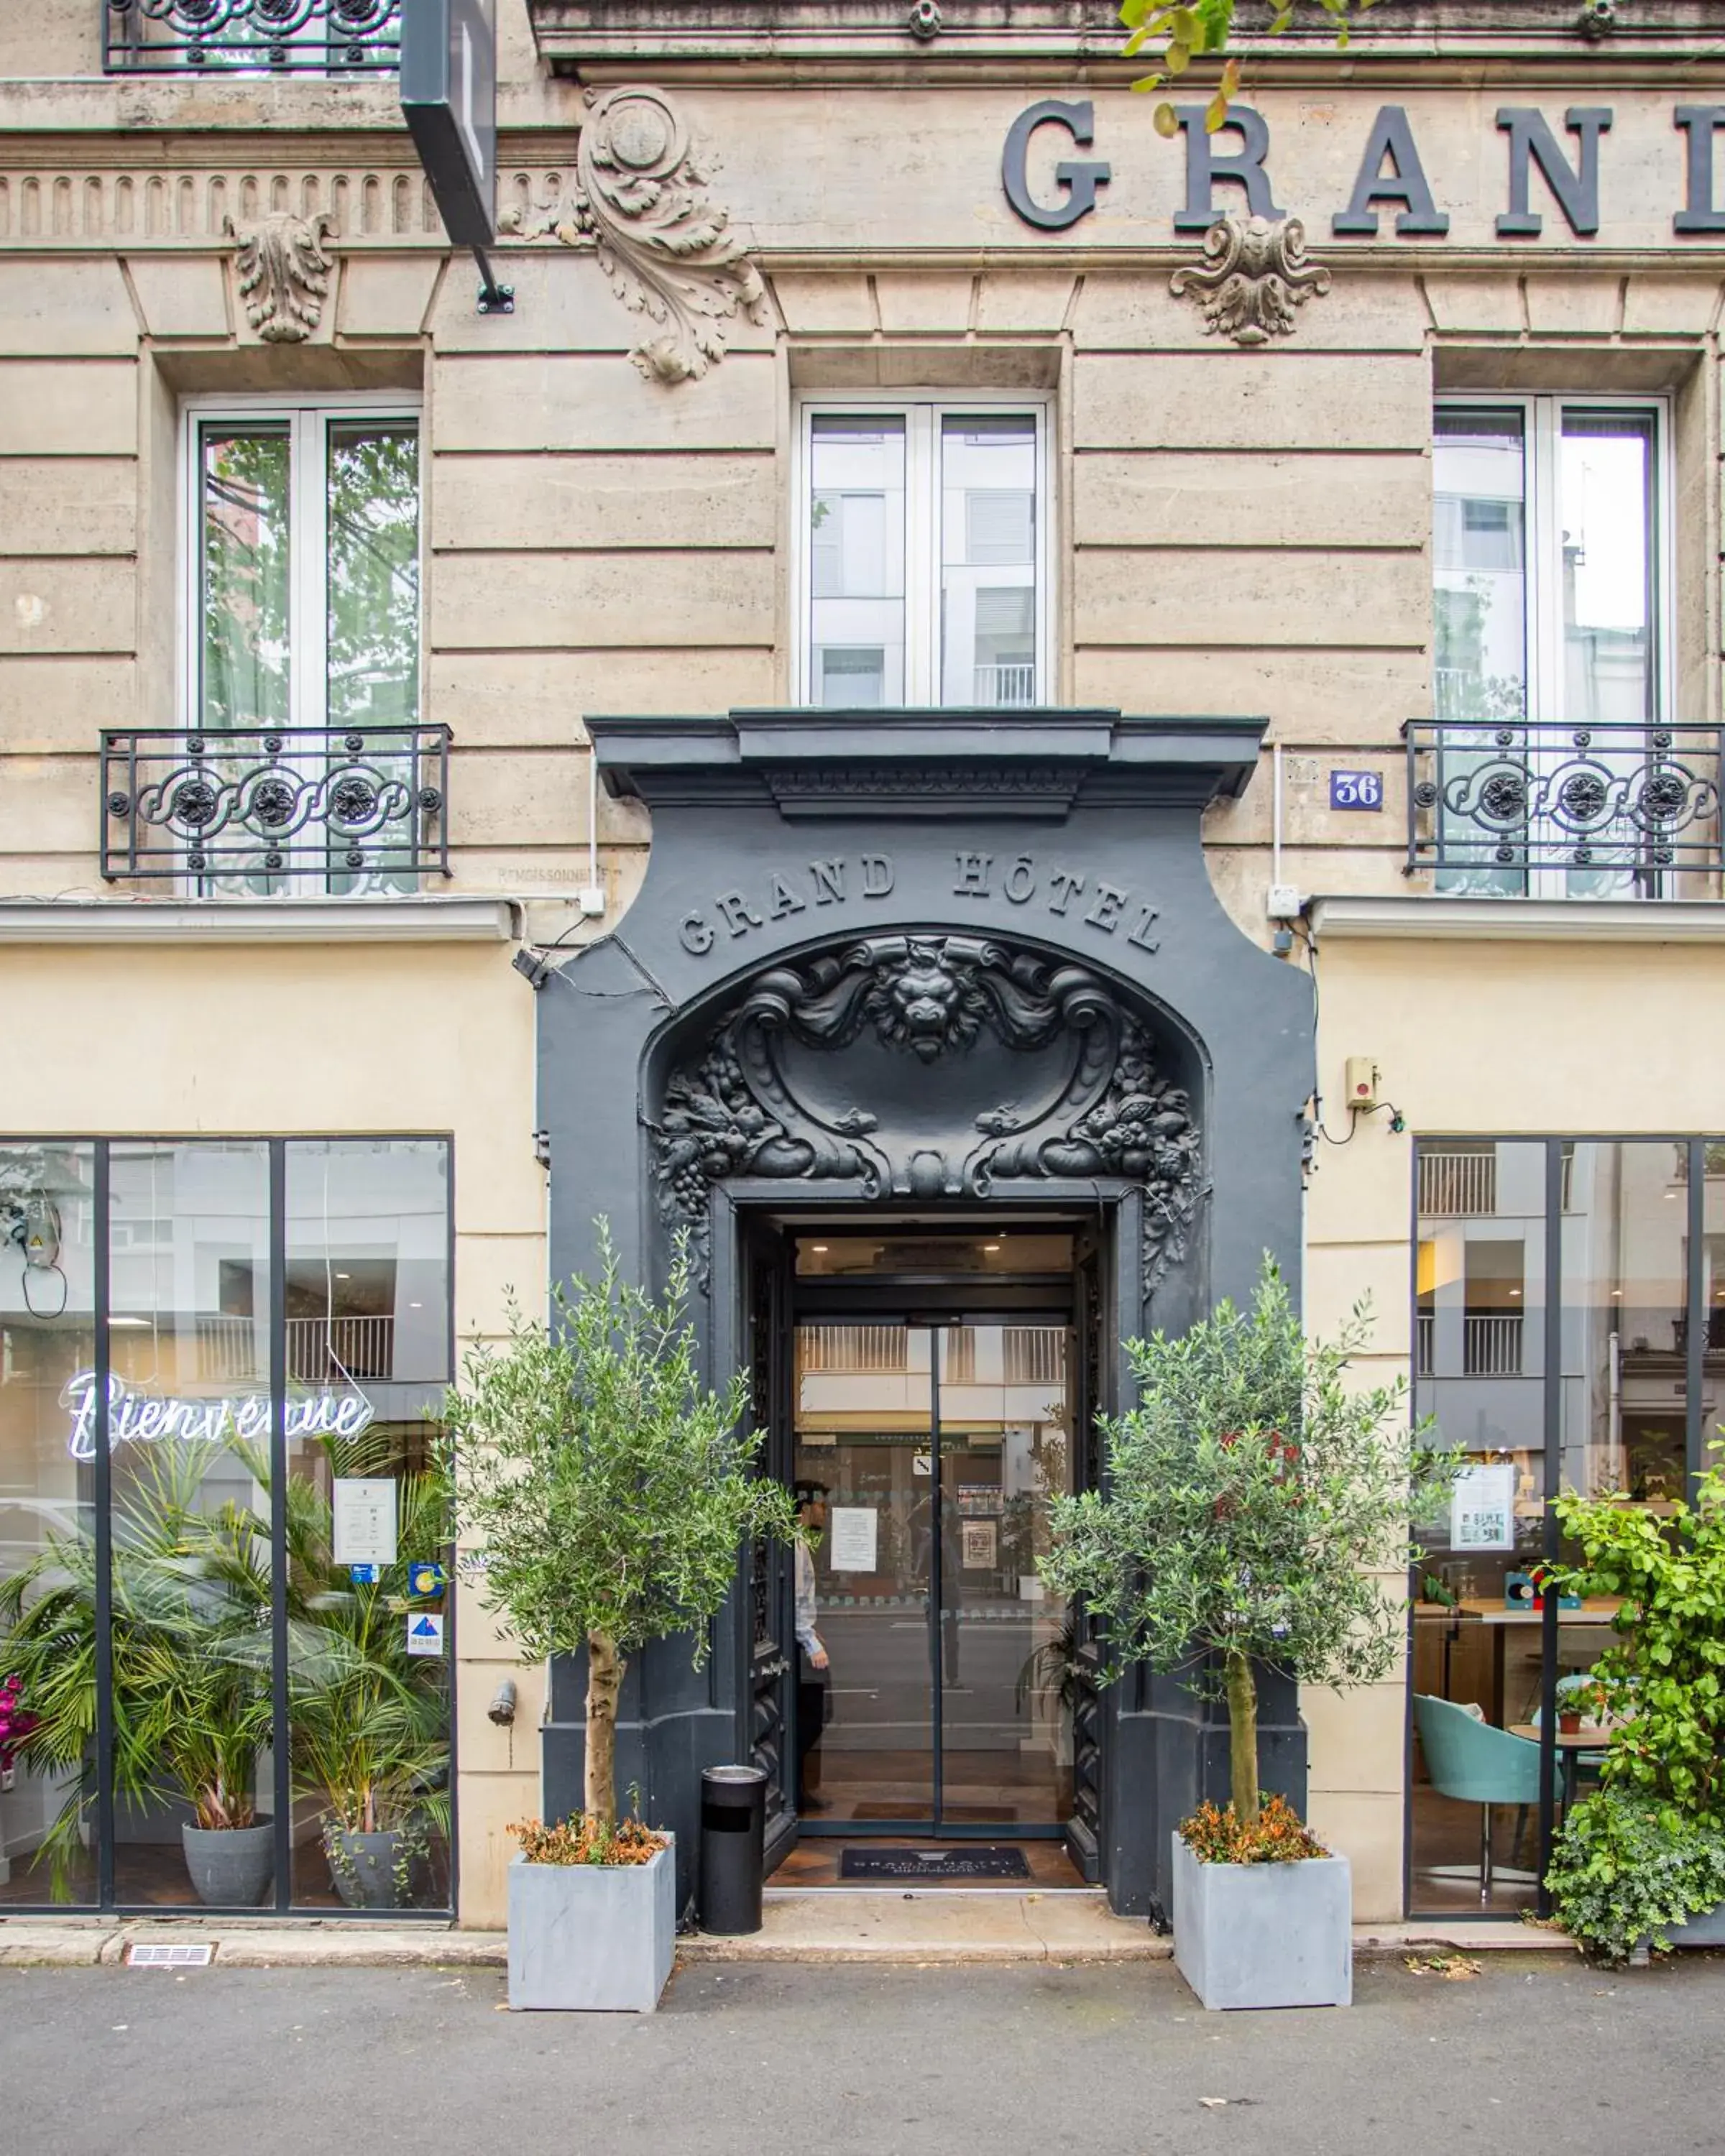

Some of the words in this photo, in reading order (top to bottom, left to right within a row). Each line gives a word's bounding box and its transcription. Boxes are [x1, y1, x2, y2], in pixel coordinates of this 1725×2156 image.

[1335, 774, 1378, 804] 36
[678, 852, 896, 955] GRAND
[953, 850, 1162, 953] HÔTEL
